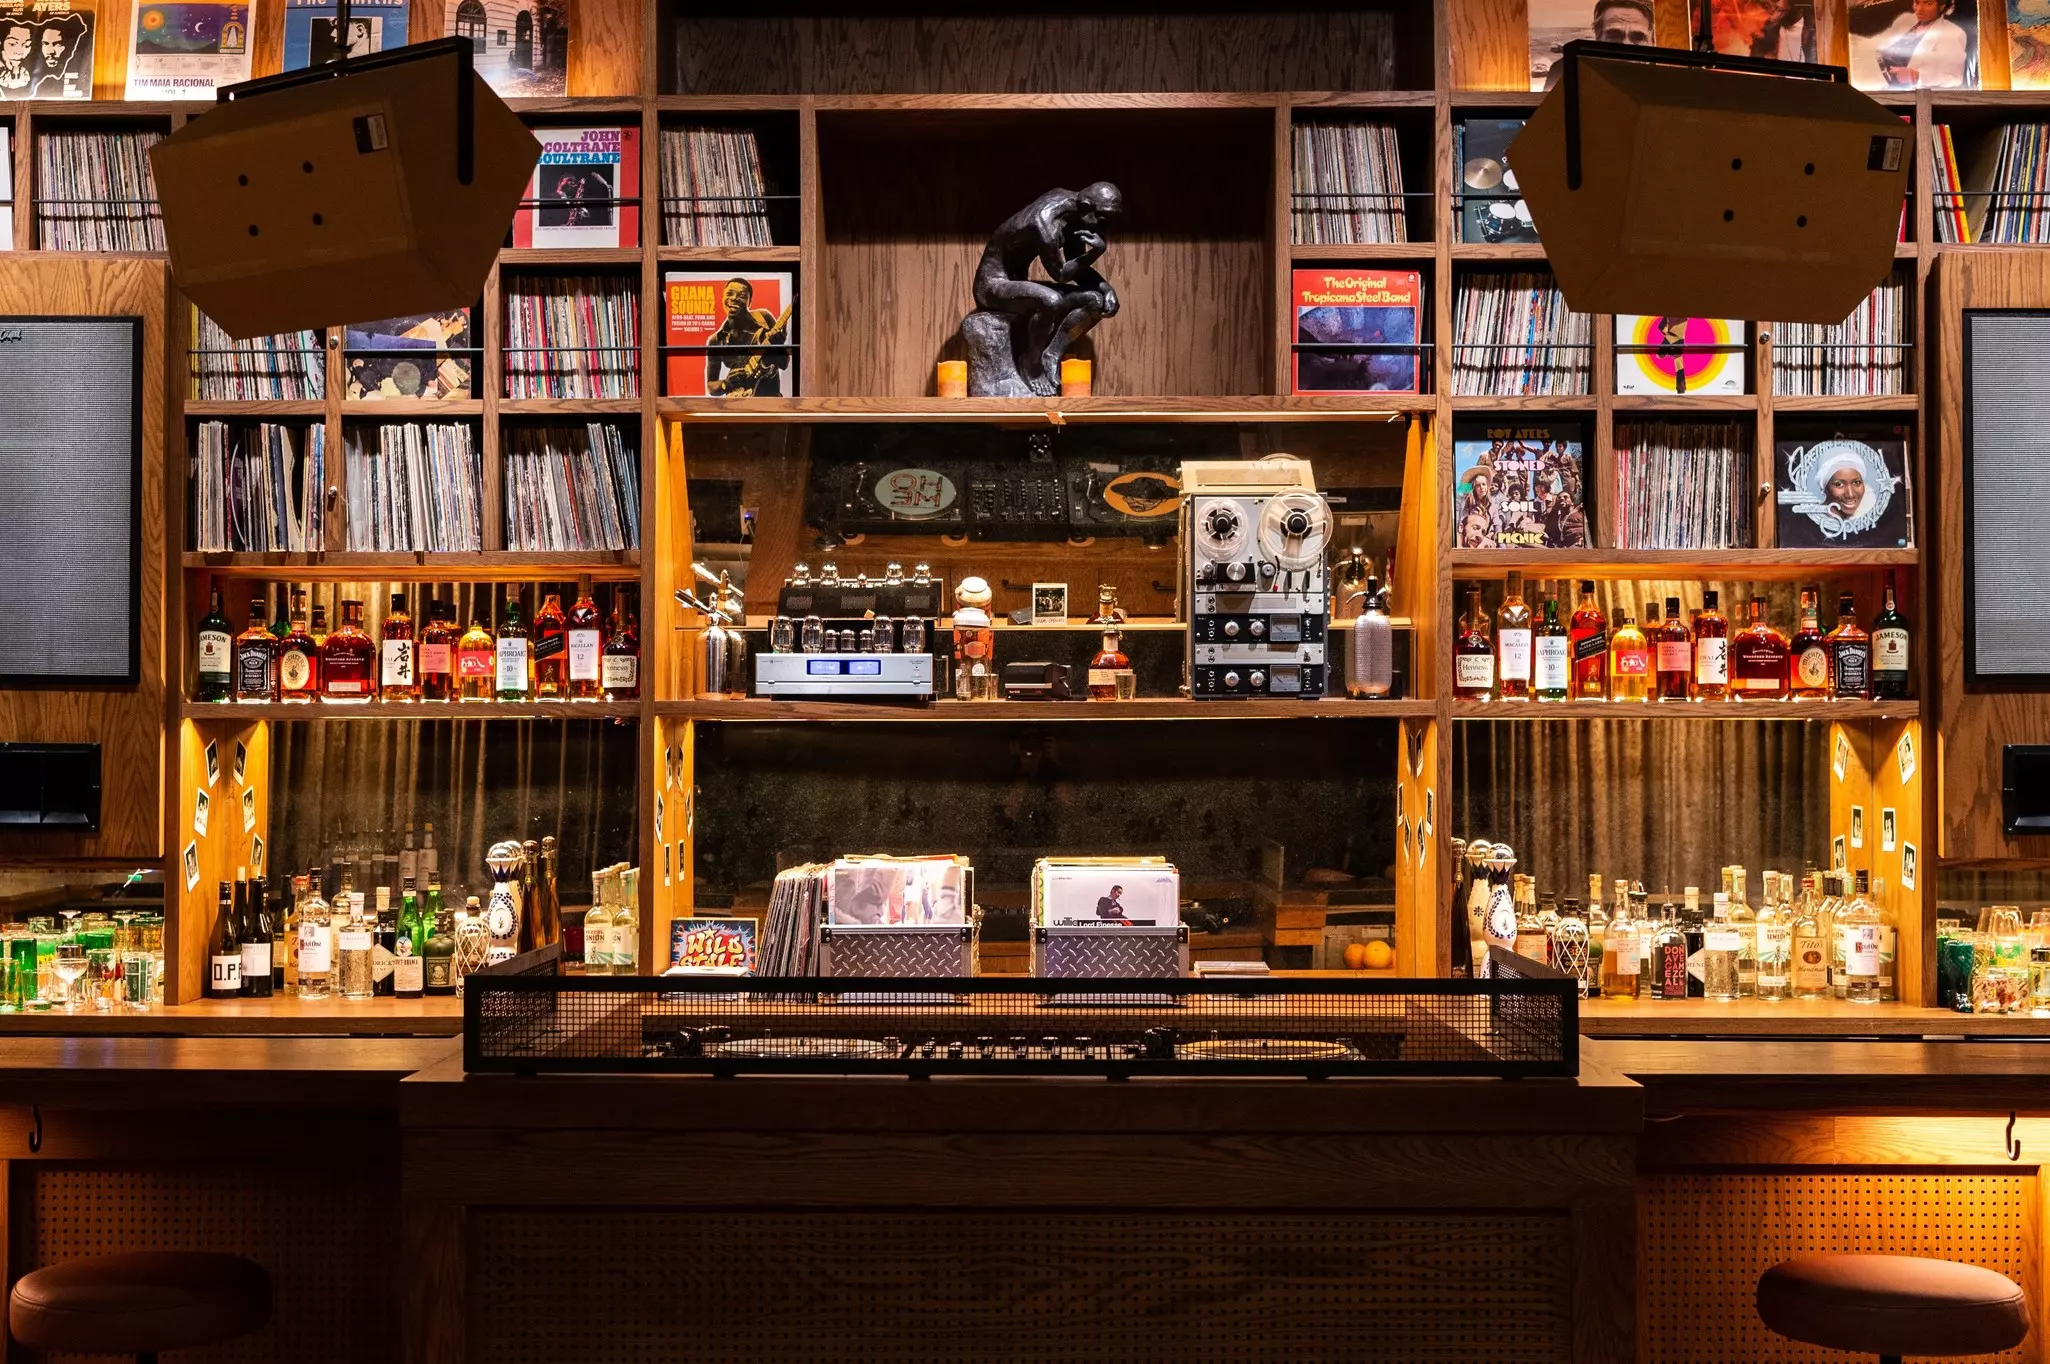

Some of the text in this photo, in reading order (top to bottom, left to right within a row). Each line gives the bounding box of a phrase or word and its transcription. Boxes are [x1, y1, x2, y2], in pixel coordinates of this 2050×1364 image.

[32, 1, 71, 11] AYERS
[134, 79, 215, 87] TIM MAIA RACIONAL
[581, 131, 620, 142] JOHN
[543, 142, 620, 153] COLTRANE
[1323, 276, 1387, 292] The Original
[670, 285, 715, 300] GHANA
[1302, 291, 1411, 305] Tropicana Steel Band
[671, 300, 716, 315] SOUNDZ
[1486, 428, 1551, 439] ROY AYERS
[1493, 460, 1546, 471] STONED
[1501, 501, 1538, 512] SOUL
[1498, 533, 1544, 544] PICNIC
[200, 634, 227, 643] AMESON
[1875, 631, 1908, 641] JAMESON
[240, 651, 251, 660] JACK
[1838, 649, 1849, 658] JACK
[506, 664, 514, 673] 10
[687, 932, 744, 955] WILD
[679, 953, 746, 968] STYLE
